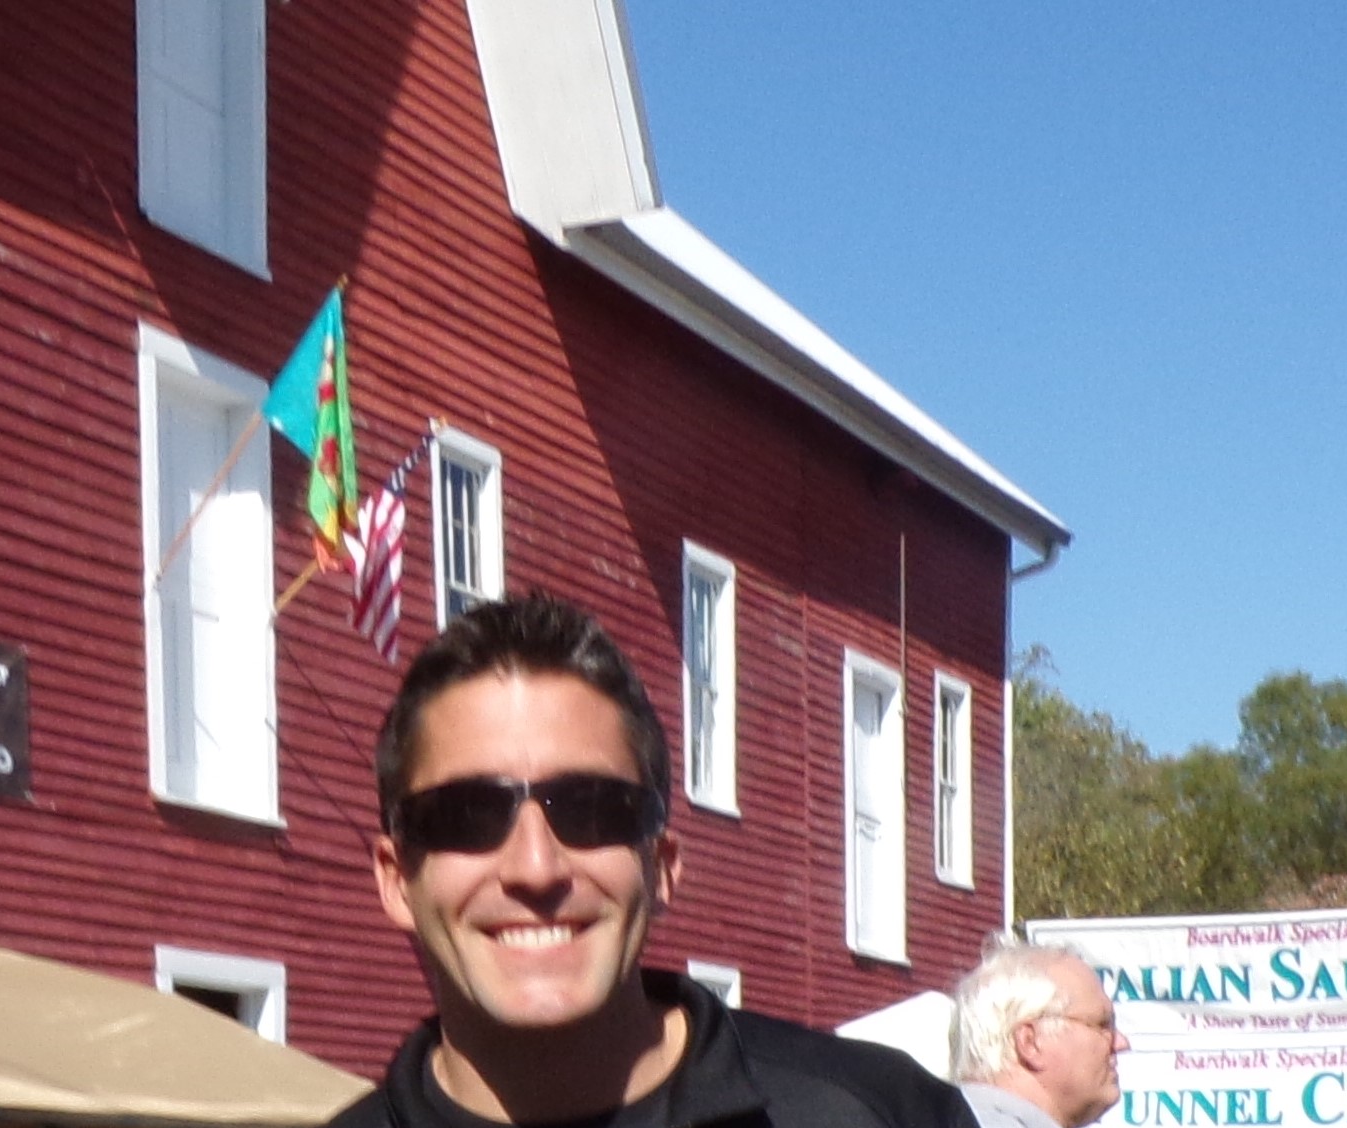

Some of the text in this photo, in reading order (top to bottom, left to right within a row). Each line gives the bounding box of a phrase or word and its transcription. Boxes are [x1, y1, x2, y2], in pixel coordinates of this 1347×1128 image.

[1187, 923, 1284, 947] Boardwalk
[1095, 965, 1252, 1003] TALIAN
[1295, 1012, 1313, 1032] of
[1174, 1048, 1268, 1069] Boardwalk
[1121, 1088, 1283, 1126] UNNEL
